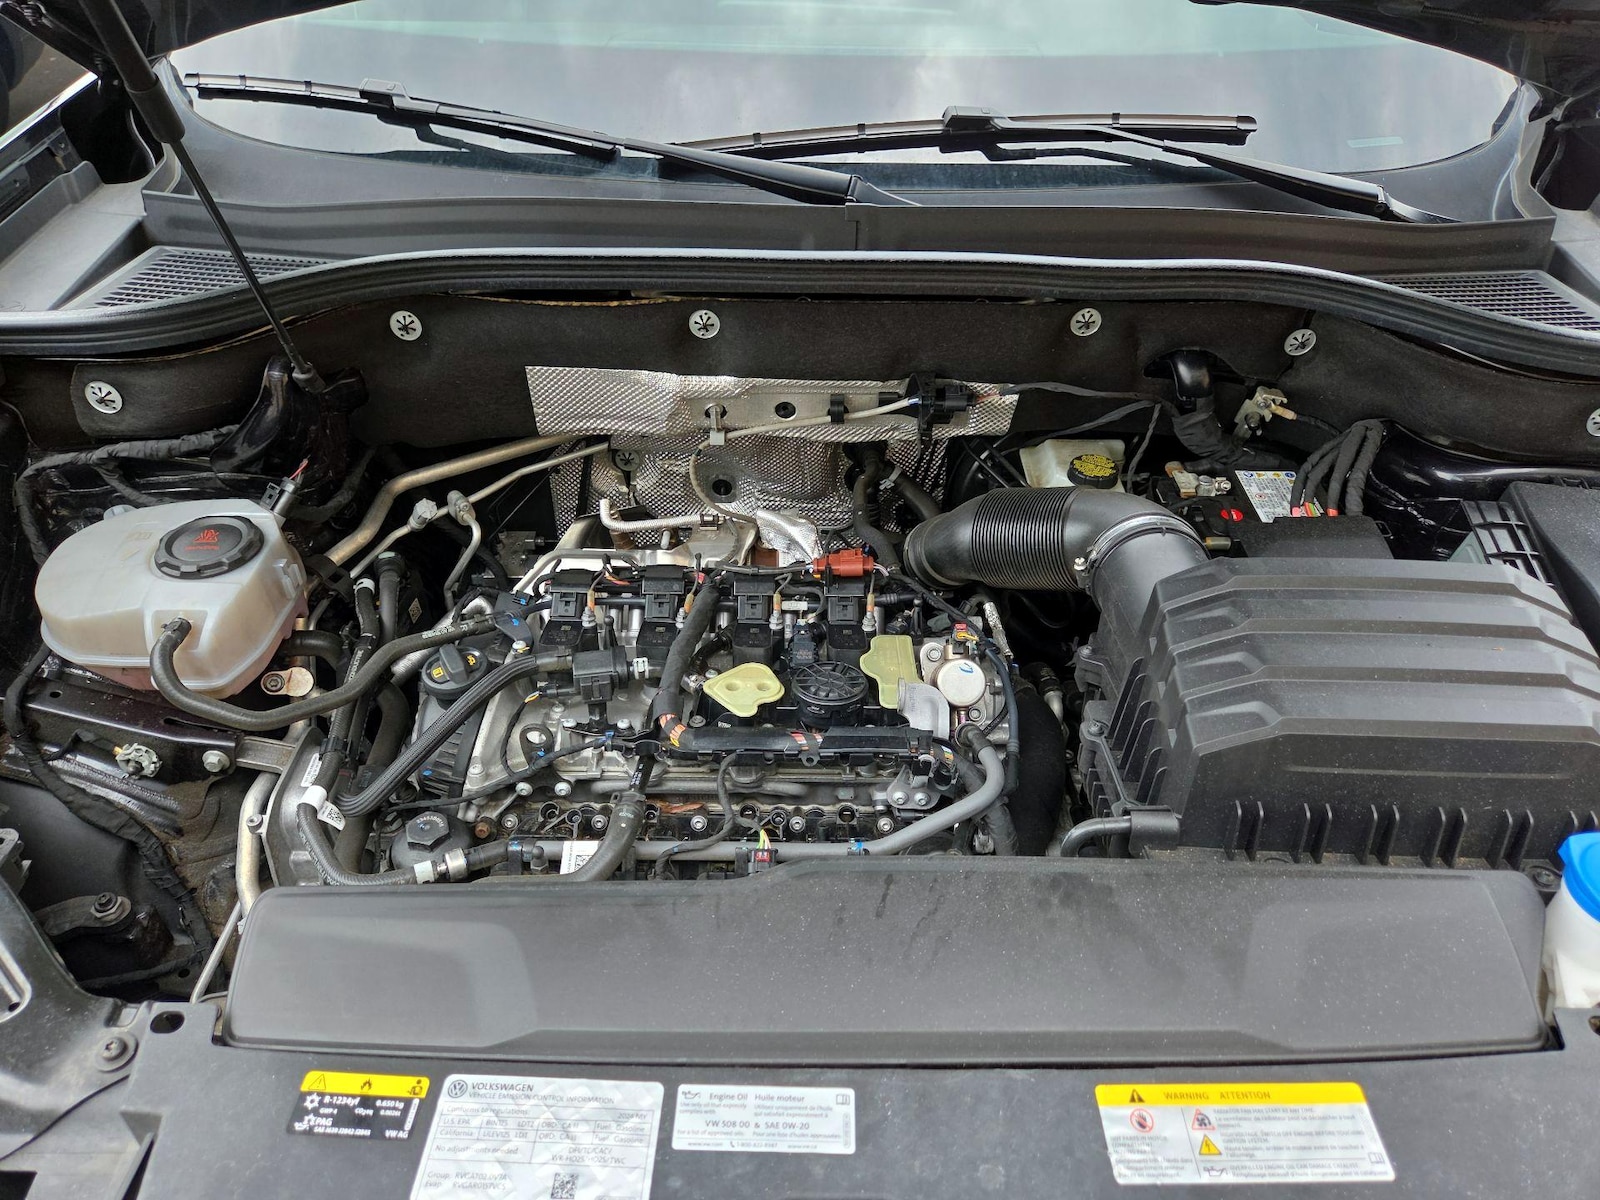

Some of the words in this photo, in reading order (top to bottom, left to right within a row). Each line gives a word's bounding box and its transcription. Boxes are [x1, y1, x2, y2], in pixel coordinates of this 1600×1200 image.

[472, 1082, 534, 1092] VOLKSWAGEN
[498, 1092, 531, 1100] EMISSION
[532, 1093, 564, 1102] CONTROL
[566, 1096, 614, 1104] INFORMATION
[709, 1092, 735, 1102] Engine
[737, 1093, 748, 1101] Oil
[754, 1094, 775, 1102] Huile
[776, 1094, 805, 1102] moteur
[1162, 1092, 1209, 1100] WARNING
[1220, 1091, 1271, 1100] ATTENTION
[324, 1096, 360, 1106] R-1234yf
[395, 1100, 404, 1109] kg
[704, 1120, 720, 1128] VW
[721, 1120, 737, 1128] 508
[782, 1122, 810, 1130] 0W-20
[385, 1130, 398, 1138] VW
[398, 1130, 408, 1138] AG
